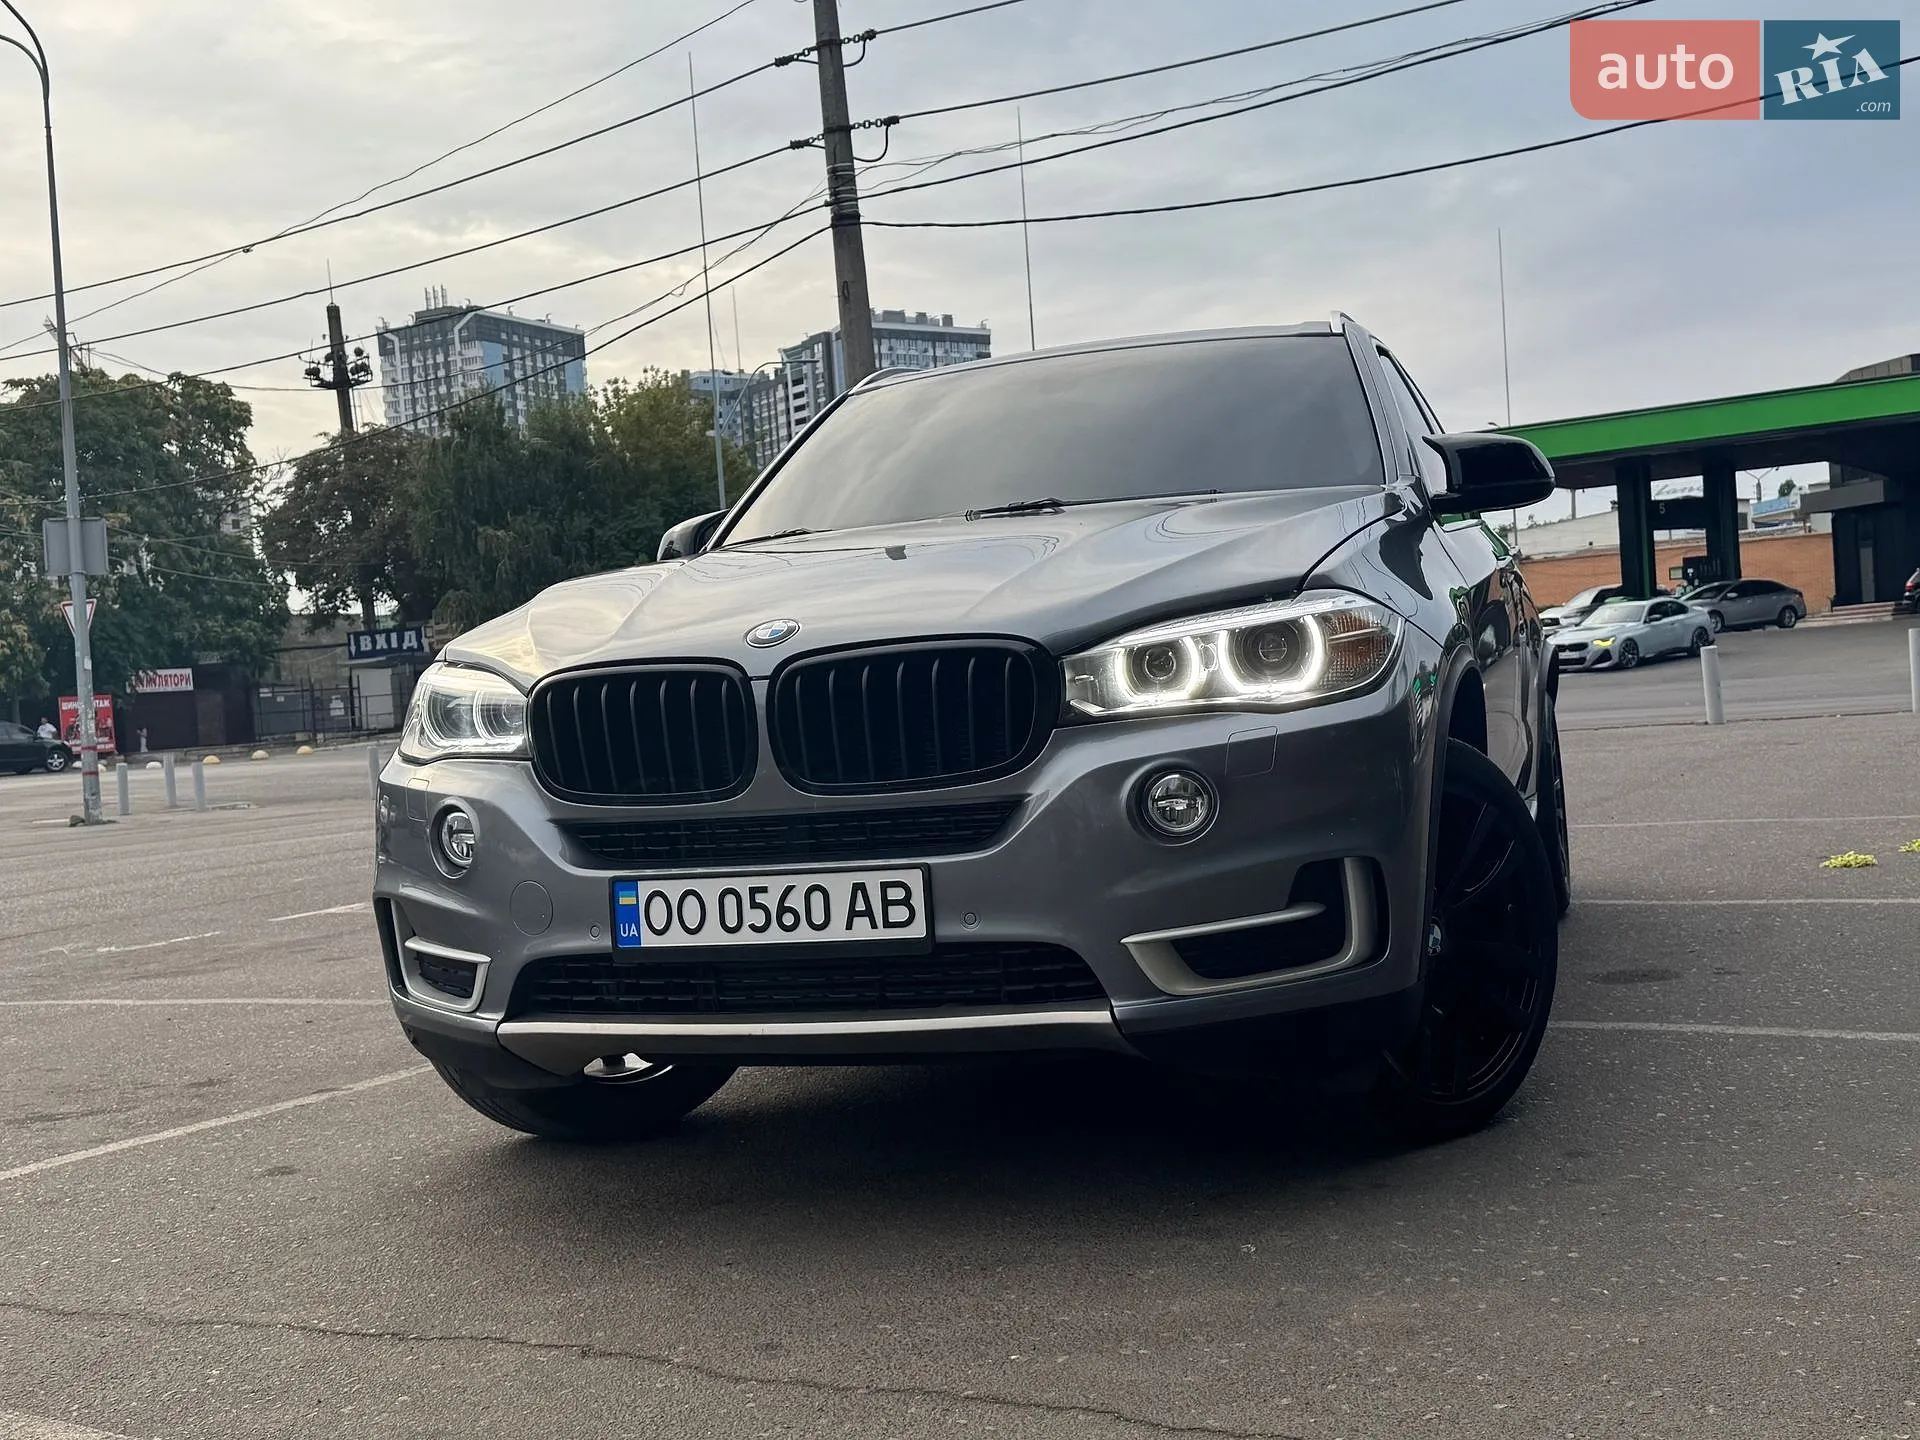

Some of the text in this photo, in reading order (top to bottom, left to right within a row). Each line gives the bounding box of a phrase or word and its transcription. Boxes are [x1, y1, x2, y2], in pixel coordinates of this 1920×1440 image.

[359, 630, 418, 651] ВХІД
[643, 880, 916, 936] OO 0560 AB
[620, 922, 639, 938] UA
